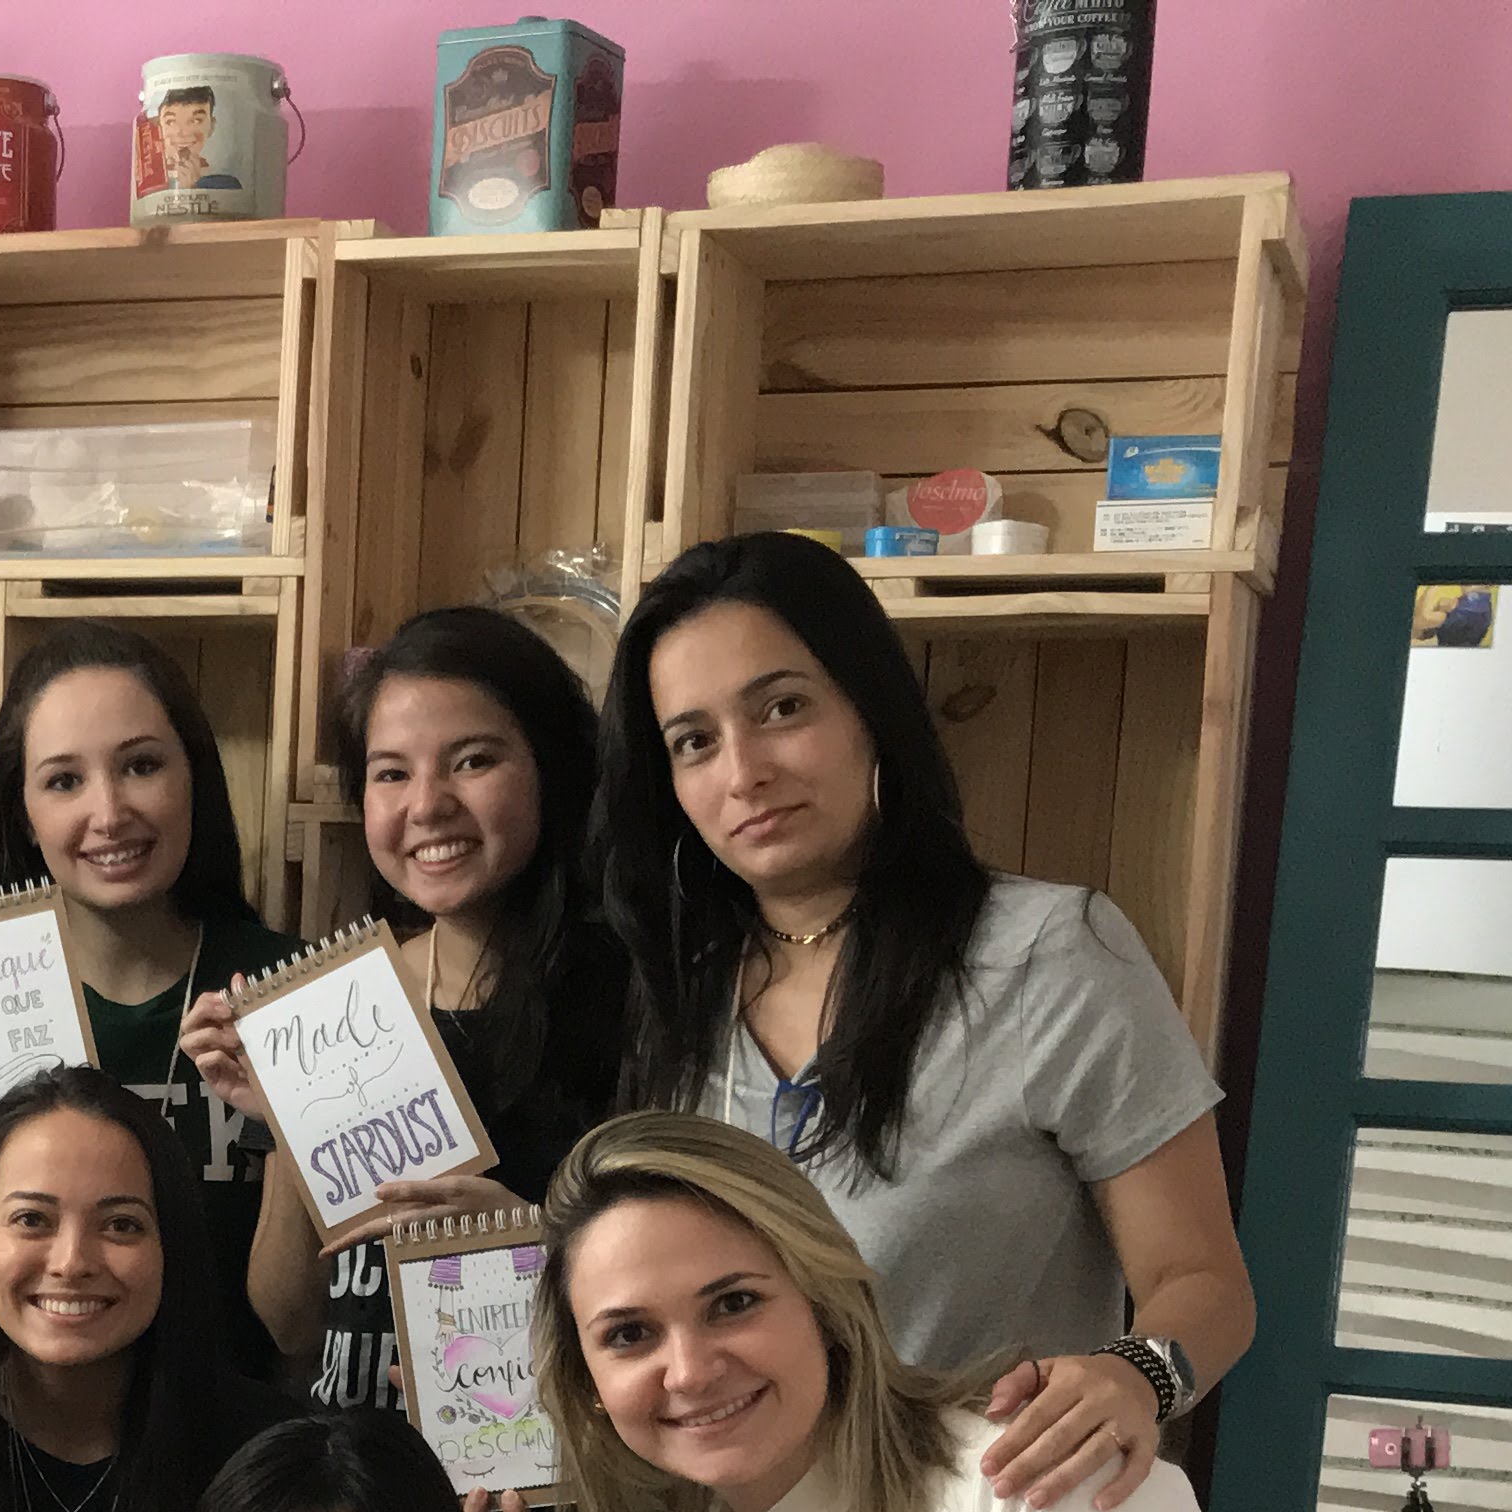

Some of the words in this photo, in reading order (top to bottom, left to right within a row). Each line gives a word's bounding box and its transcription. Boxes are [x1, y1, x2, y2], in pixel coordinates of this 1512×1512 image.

[451, 102, 543, 152] BISCUITS
[1, 988, 45, 1016] QUE
[7, 1023, 54, 1052] FAZ
[264, 979, 396, 1076] Made
[310, 1088, 458, 1206] STARDUST
